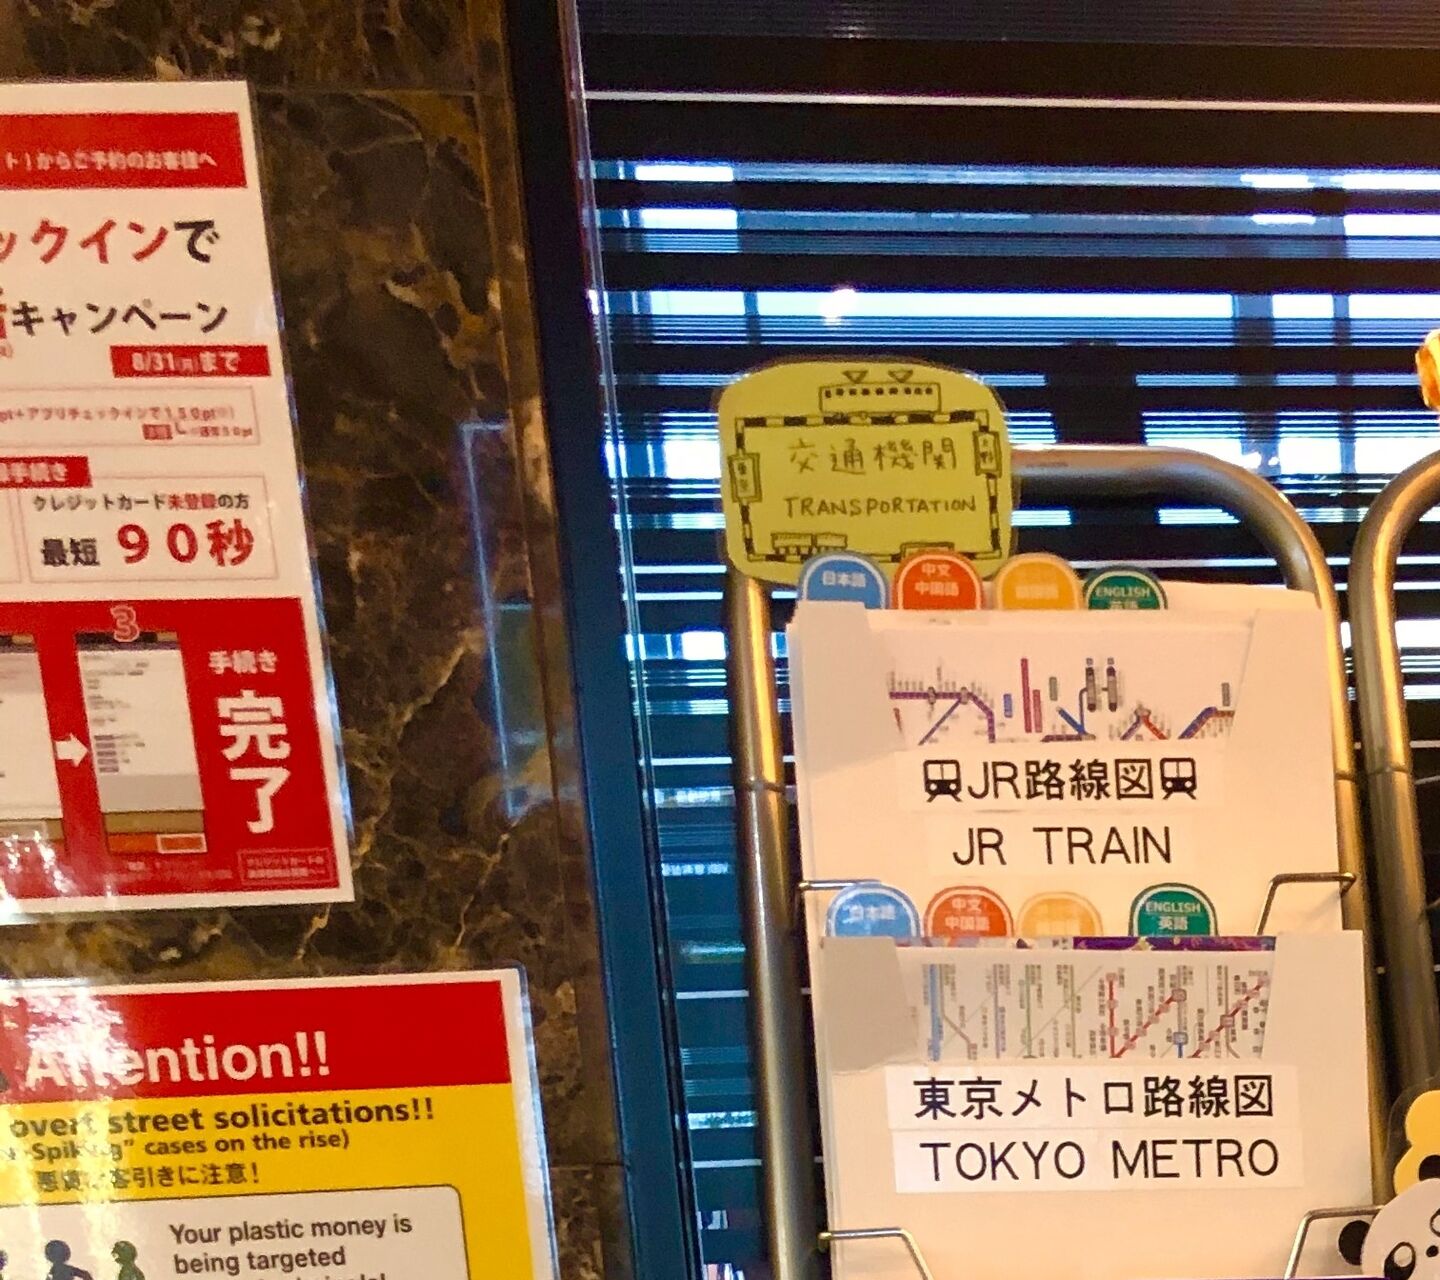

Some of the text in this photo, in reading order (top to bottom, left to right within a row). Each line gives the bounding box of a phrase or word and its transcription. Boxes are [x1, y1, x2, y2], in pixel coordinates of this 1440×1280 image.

[12, 297, 229, 336] キャンペーン
[783, 496, 977, 518] TRANSPORTATION
[822, 570, 867, 588] 日本語
[1095, 585, 1151, 598] ENGLISH
[216, 689, 291, 834] 完了
[966, 758, 1154, 801] JR路線図
[952, 826, 1172, 865] JR TRAIN
[1145, 901, 1201, 914] ENGLISH
[914, 1075, 1274, 1120] 東京メトロ路線図
[108, 1097, 434, 1134] street solicitations!!
[144, 1140, 207, 1156] cases
[215, 1138, 246, 1152] on
[252, 1133, 291, 1151] the
[298, 1131, 350, 1151] rise)
[919, 1139, 1279, 1183] TOKYO METRO
[168, 1213, 413, 1246] Your plastic money is
[174, 1246, 347, 1276] being targeted
